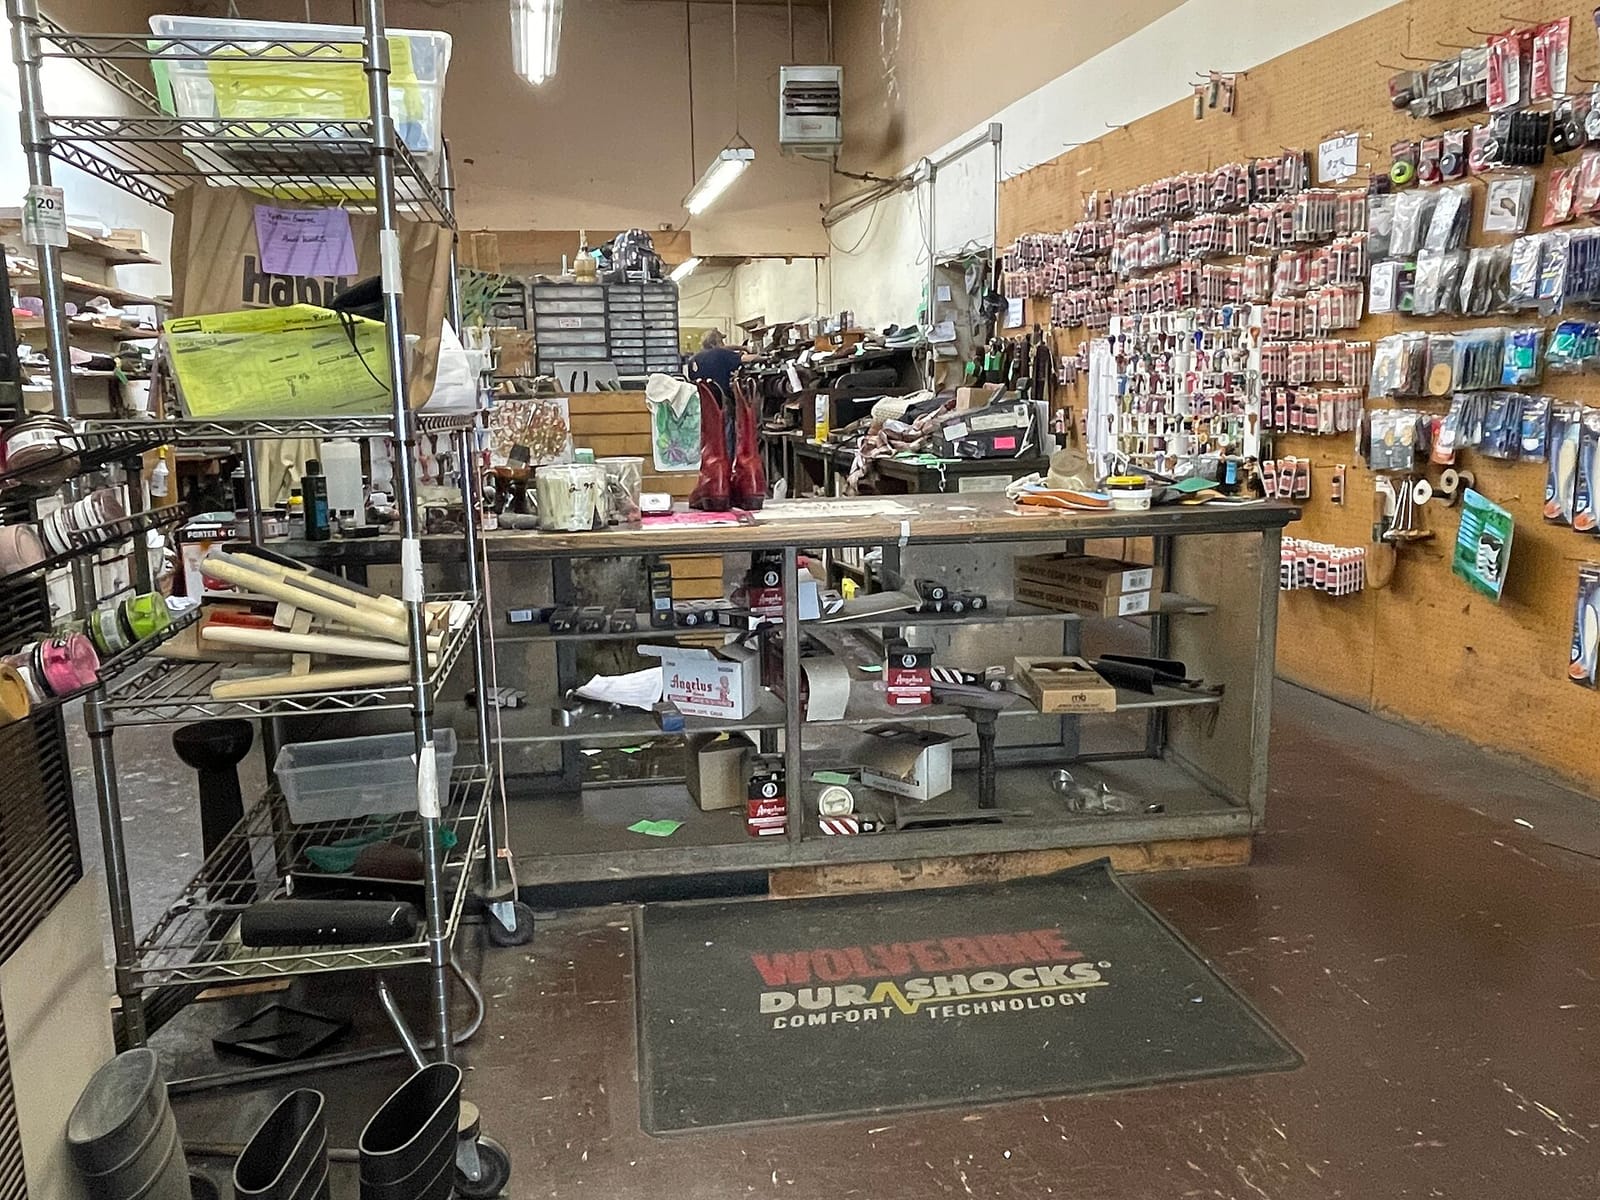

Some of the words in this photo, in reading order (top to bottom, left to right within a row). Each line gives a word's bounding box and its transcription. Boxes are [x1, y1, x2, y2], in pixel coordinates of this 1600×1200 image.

[36, 197, 54, 210] 20
[187, 530, 218, 539] PORTER
[670, 674, 712, 693] Angelus
[752, 928, 1084, 985] WOLVERINE
[773, 1006, 893, 1029] COMFORT
[926, 992, 1087, 1019] TECHNOLOGY
